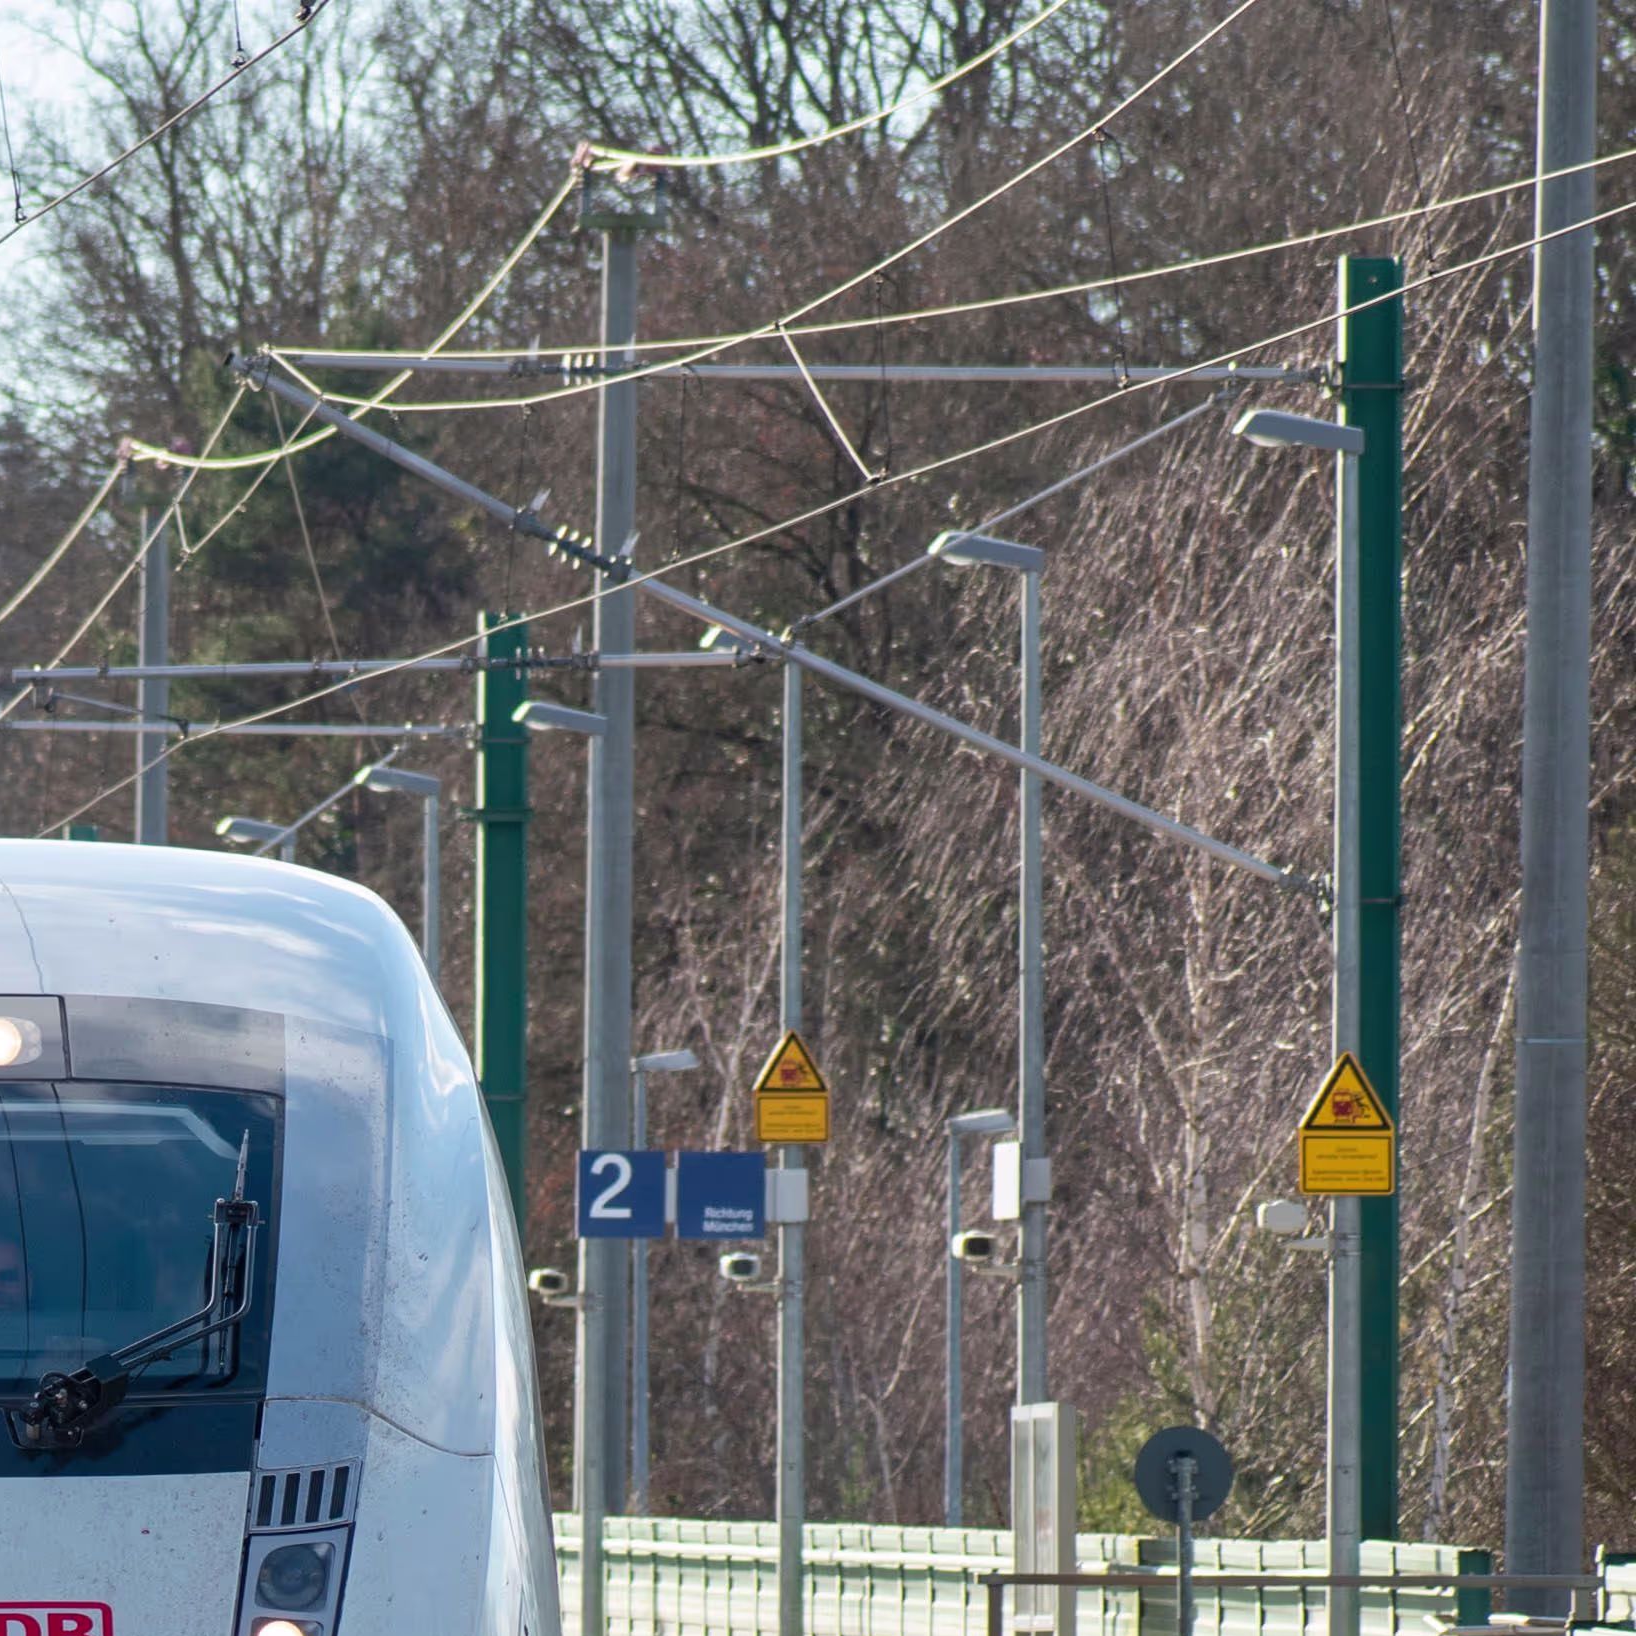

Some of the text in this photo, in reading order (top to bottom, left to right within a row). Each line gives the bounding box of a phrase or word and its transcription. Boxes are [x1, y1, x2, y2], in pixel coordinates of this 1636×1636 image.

[589, 1153, 632, 1218] 2
[704, 1207, 753, 1221] Richtung
[703, 1220, 753, 1232] München
